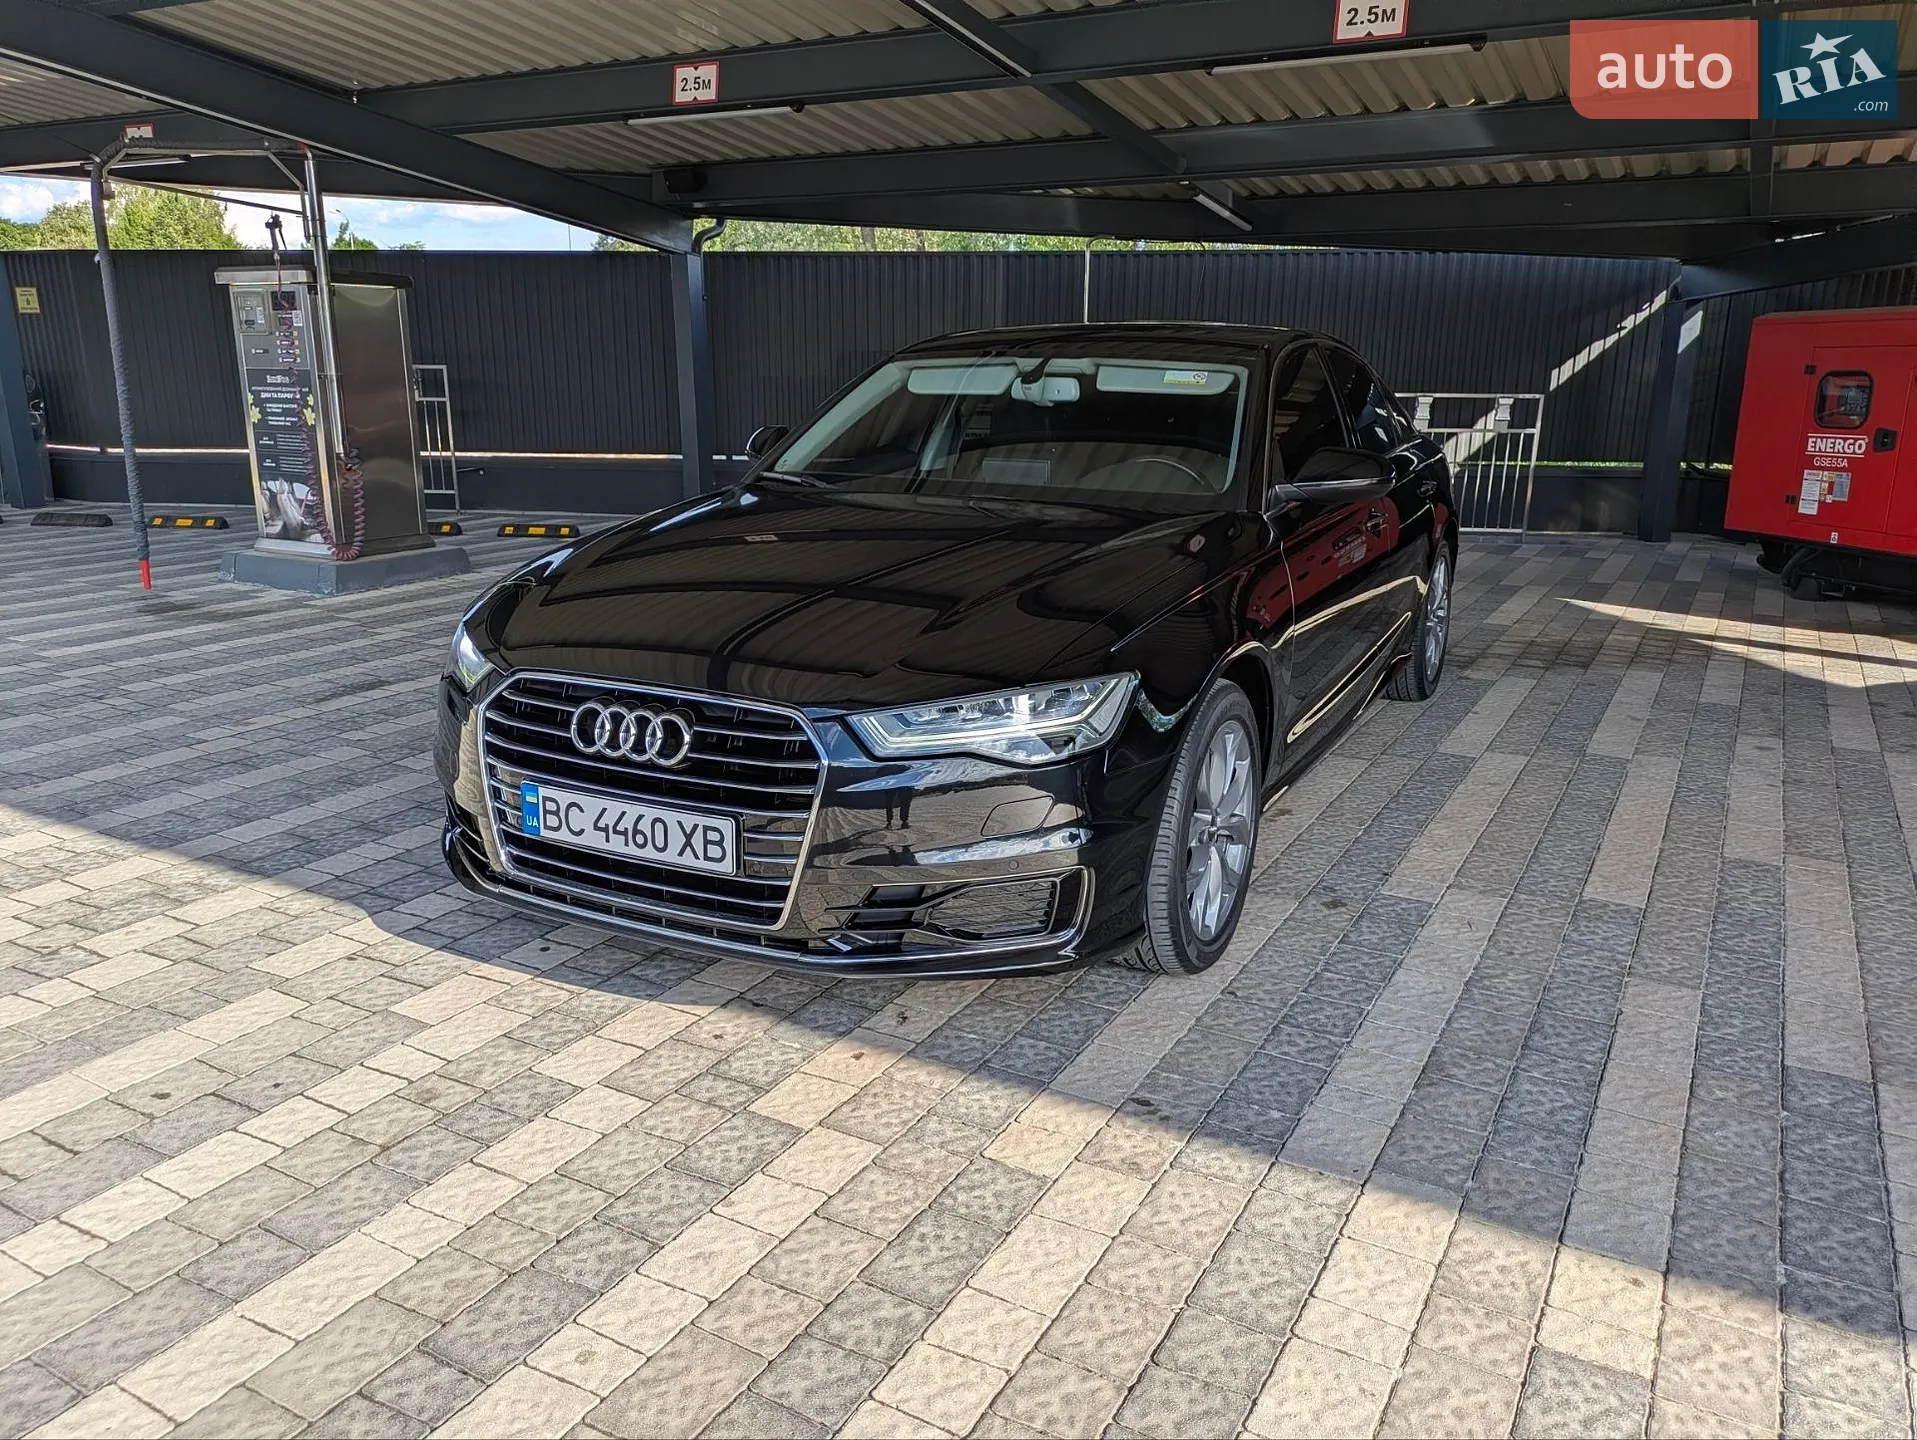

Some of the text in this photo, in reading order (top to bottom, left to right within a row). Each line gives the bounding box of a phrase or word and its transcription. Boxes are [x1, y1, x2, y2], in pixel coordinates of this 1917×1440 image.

[1807, 437, 1866, 454] ENERGO
[1813, 457, 1849, 468] GSE55A
[526, 815, 539, 827] UA
[542, 796, 727, 863] BC 4460 XB
